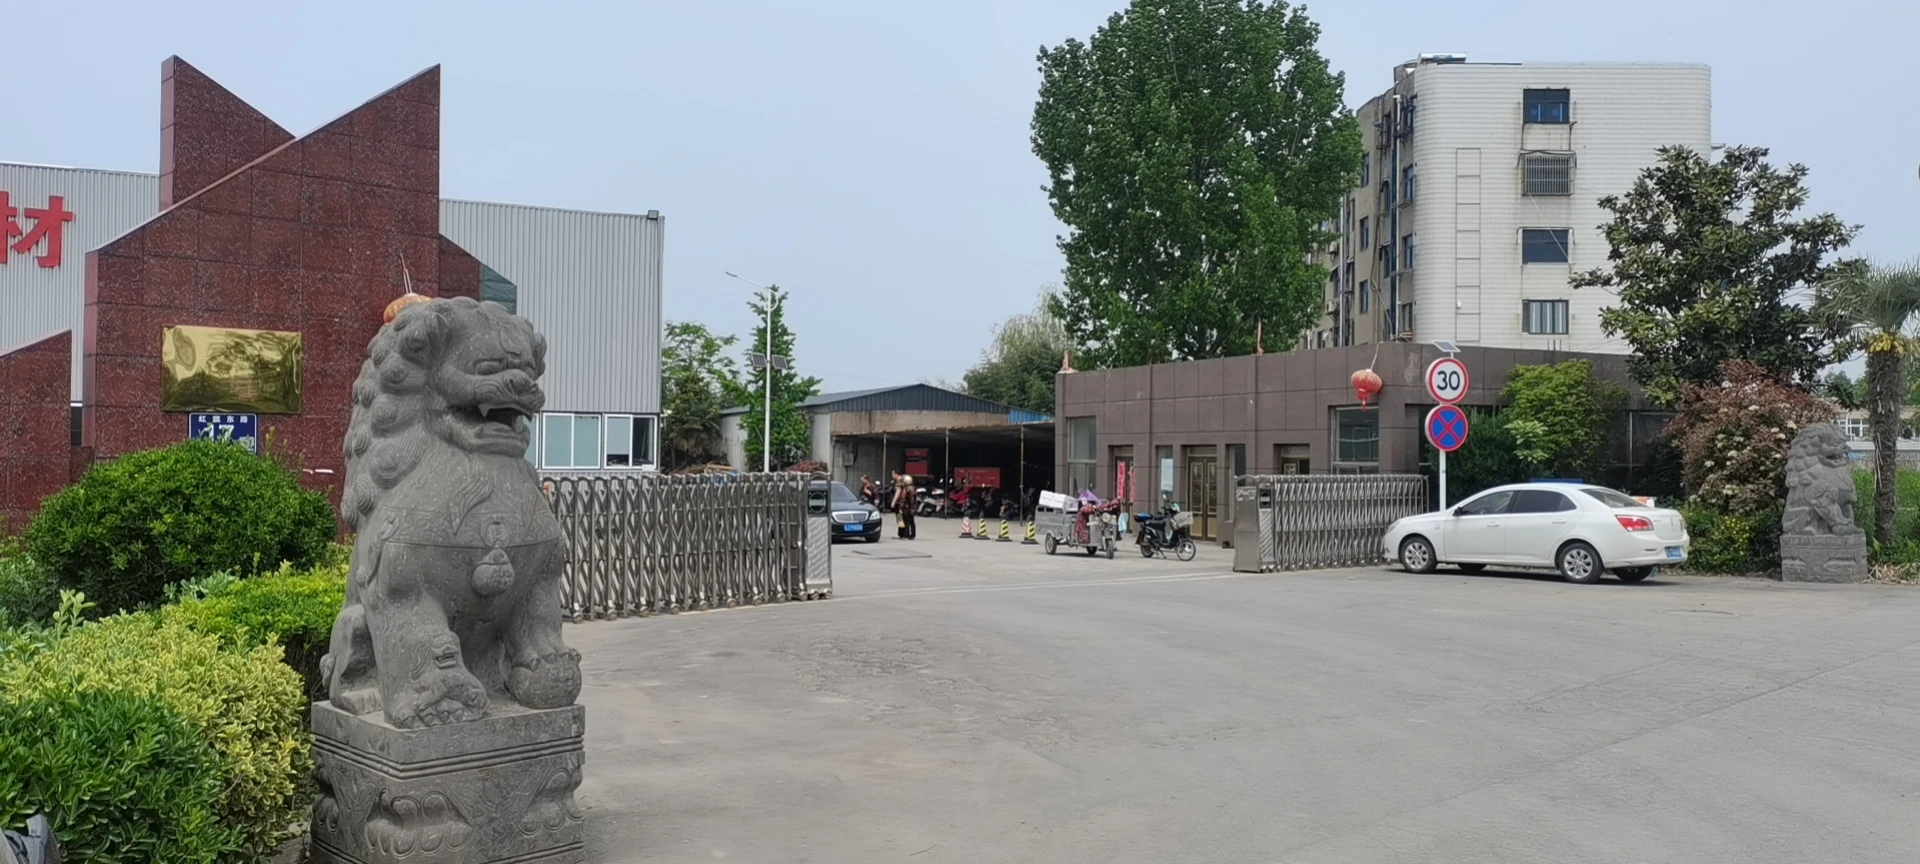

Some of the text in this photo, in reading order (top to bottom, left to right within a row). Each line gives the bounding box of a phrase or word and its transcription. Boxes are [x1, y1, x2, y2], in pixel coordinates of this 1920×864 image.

[0, 191, 73, 268] 材
[1436, 370, 1460, 391] 30
[198, 415, 248, 424] 红旗东路
[203, 423, 234, 443] 17
